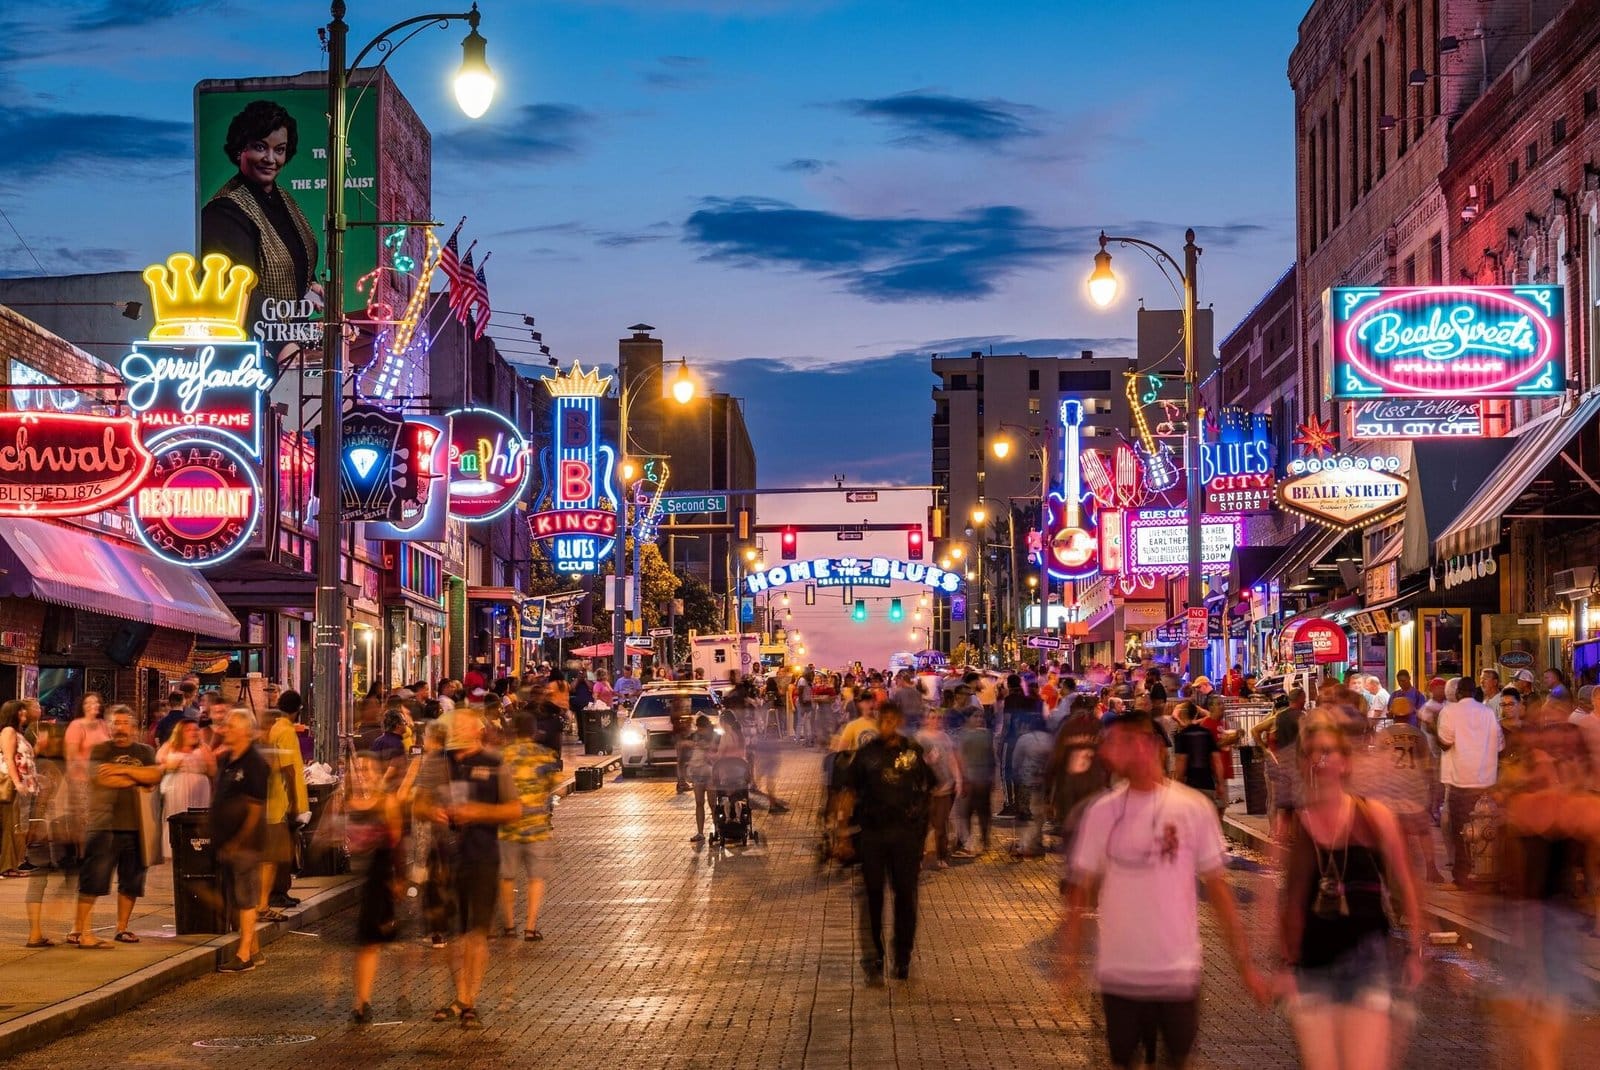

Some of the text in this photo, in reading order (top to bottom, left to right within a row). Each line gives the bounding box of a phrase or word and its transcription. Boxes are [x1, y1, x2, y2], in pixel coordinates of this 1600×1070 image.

[291, 177, 374, 190] THE SPALIST
[261, 297, 315, 321] GOLD
[253, 320, 320, 341] STRIKE
[1358, 305, 1535, 356] Beale Sweets
[121, 353, 200, 411] Jerry
[1355, 400, 1409, 418] Miss
[141, 413, 251, 426] HALL OF FAME
[567, 411, 588, 446] B
[1356, 423, 1481, 436] SOUL CITY CAFE
[0, 426, 137, 472] chwab
[167, 448, 223, 469] BAR
[1199, 440, 1268, 485] BLUES
[560, 460, 592, 502] B
[1211, 474, 1270, 490] CITY
[0, 484, 102, 501] BLISHED 1876
[1209, 489, 1270, 503] GENERAL
[1291, 483, 1402, 500] BEALE STREET
[138, 486, 251, 518] RESTAURANT
[667, 499, 705, 512] Second
[706, 498, 723, 510] St.
[1219, 500, 1261, 511] STORE
[1139, 509, 1187, 520] BLUES CITY
[536, 514, 616, 533] KING'S
[1161, 528, 1178, 536] MUSIC
[558, 538, 595, 559] BLUES
[1149, 537, 1167, 546] EARL
[1214, 543, 1231, 551] 5PM
[558, 560, 595, 571] CLUB
[841, 557, 858, 567] OF
[747, 557, 961, 594] HOME BLUES
[838, 567, 861, 576] THE
[822, 576, 885, 585] BEALE STREET
